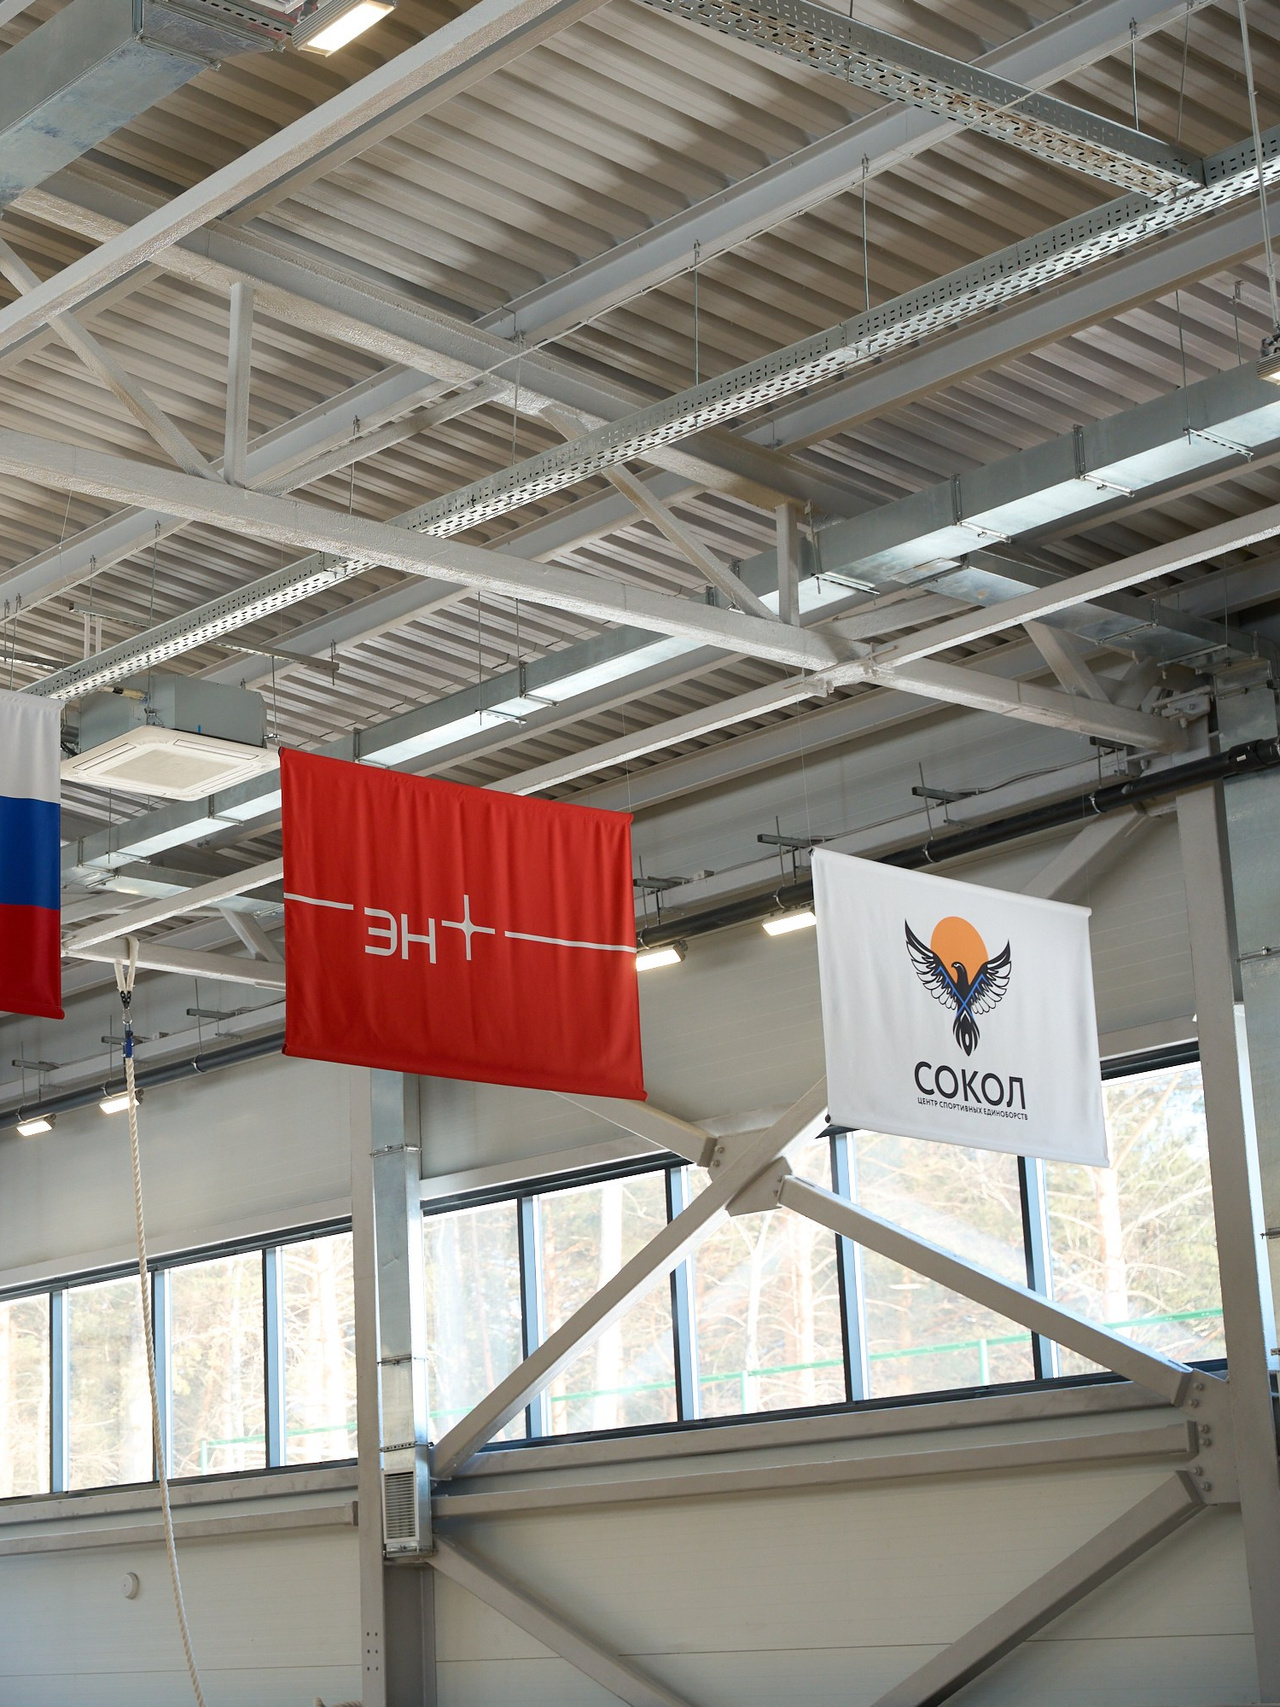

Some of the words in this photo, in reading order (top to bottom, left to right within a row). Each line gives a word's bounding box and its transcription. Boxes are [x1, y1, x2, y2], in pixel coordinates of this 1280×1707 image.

[914, 1060, 1026, 1110] СОКОЛ
[917, 1097, 938, 1107] ЦЕНТР
[939, 1100, 983, 1114] СПОРТИВНЫХ
[983, 1107, 1028, 1120] ЕДИНОБОРСТВ
